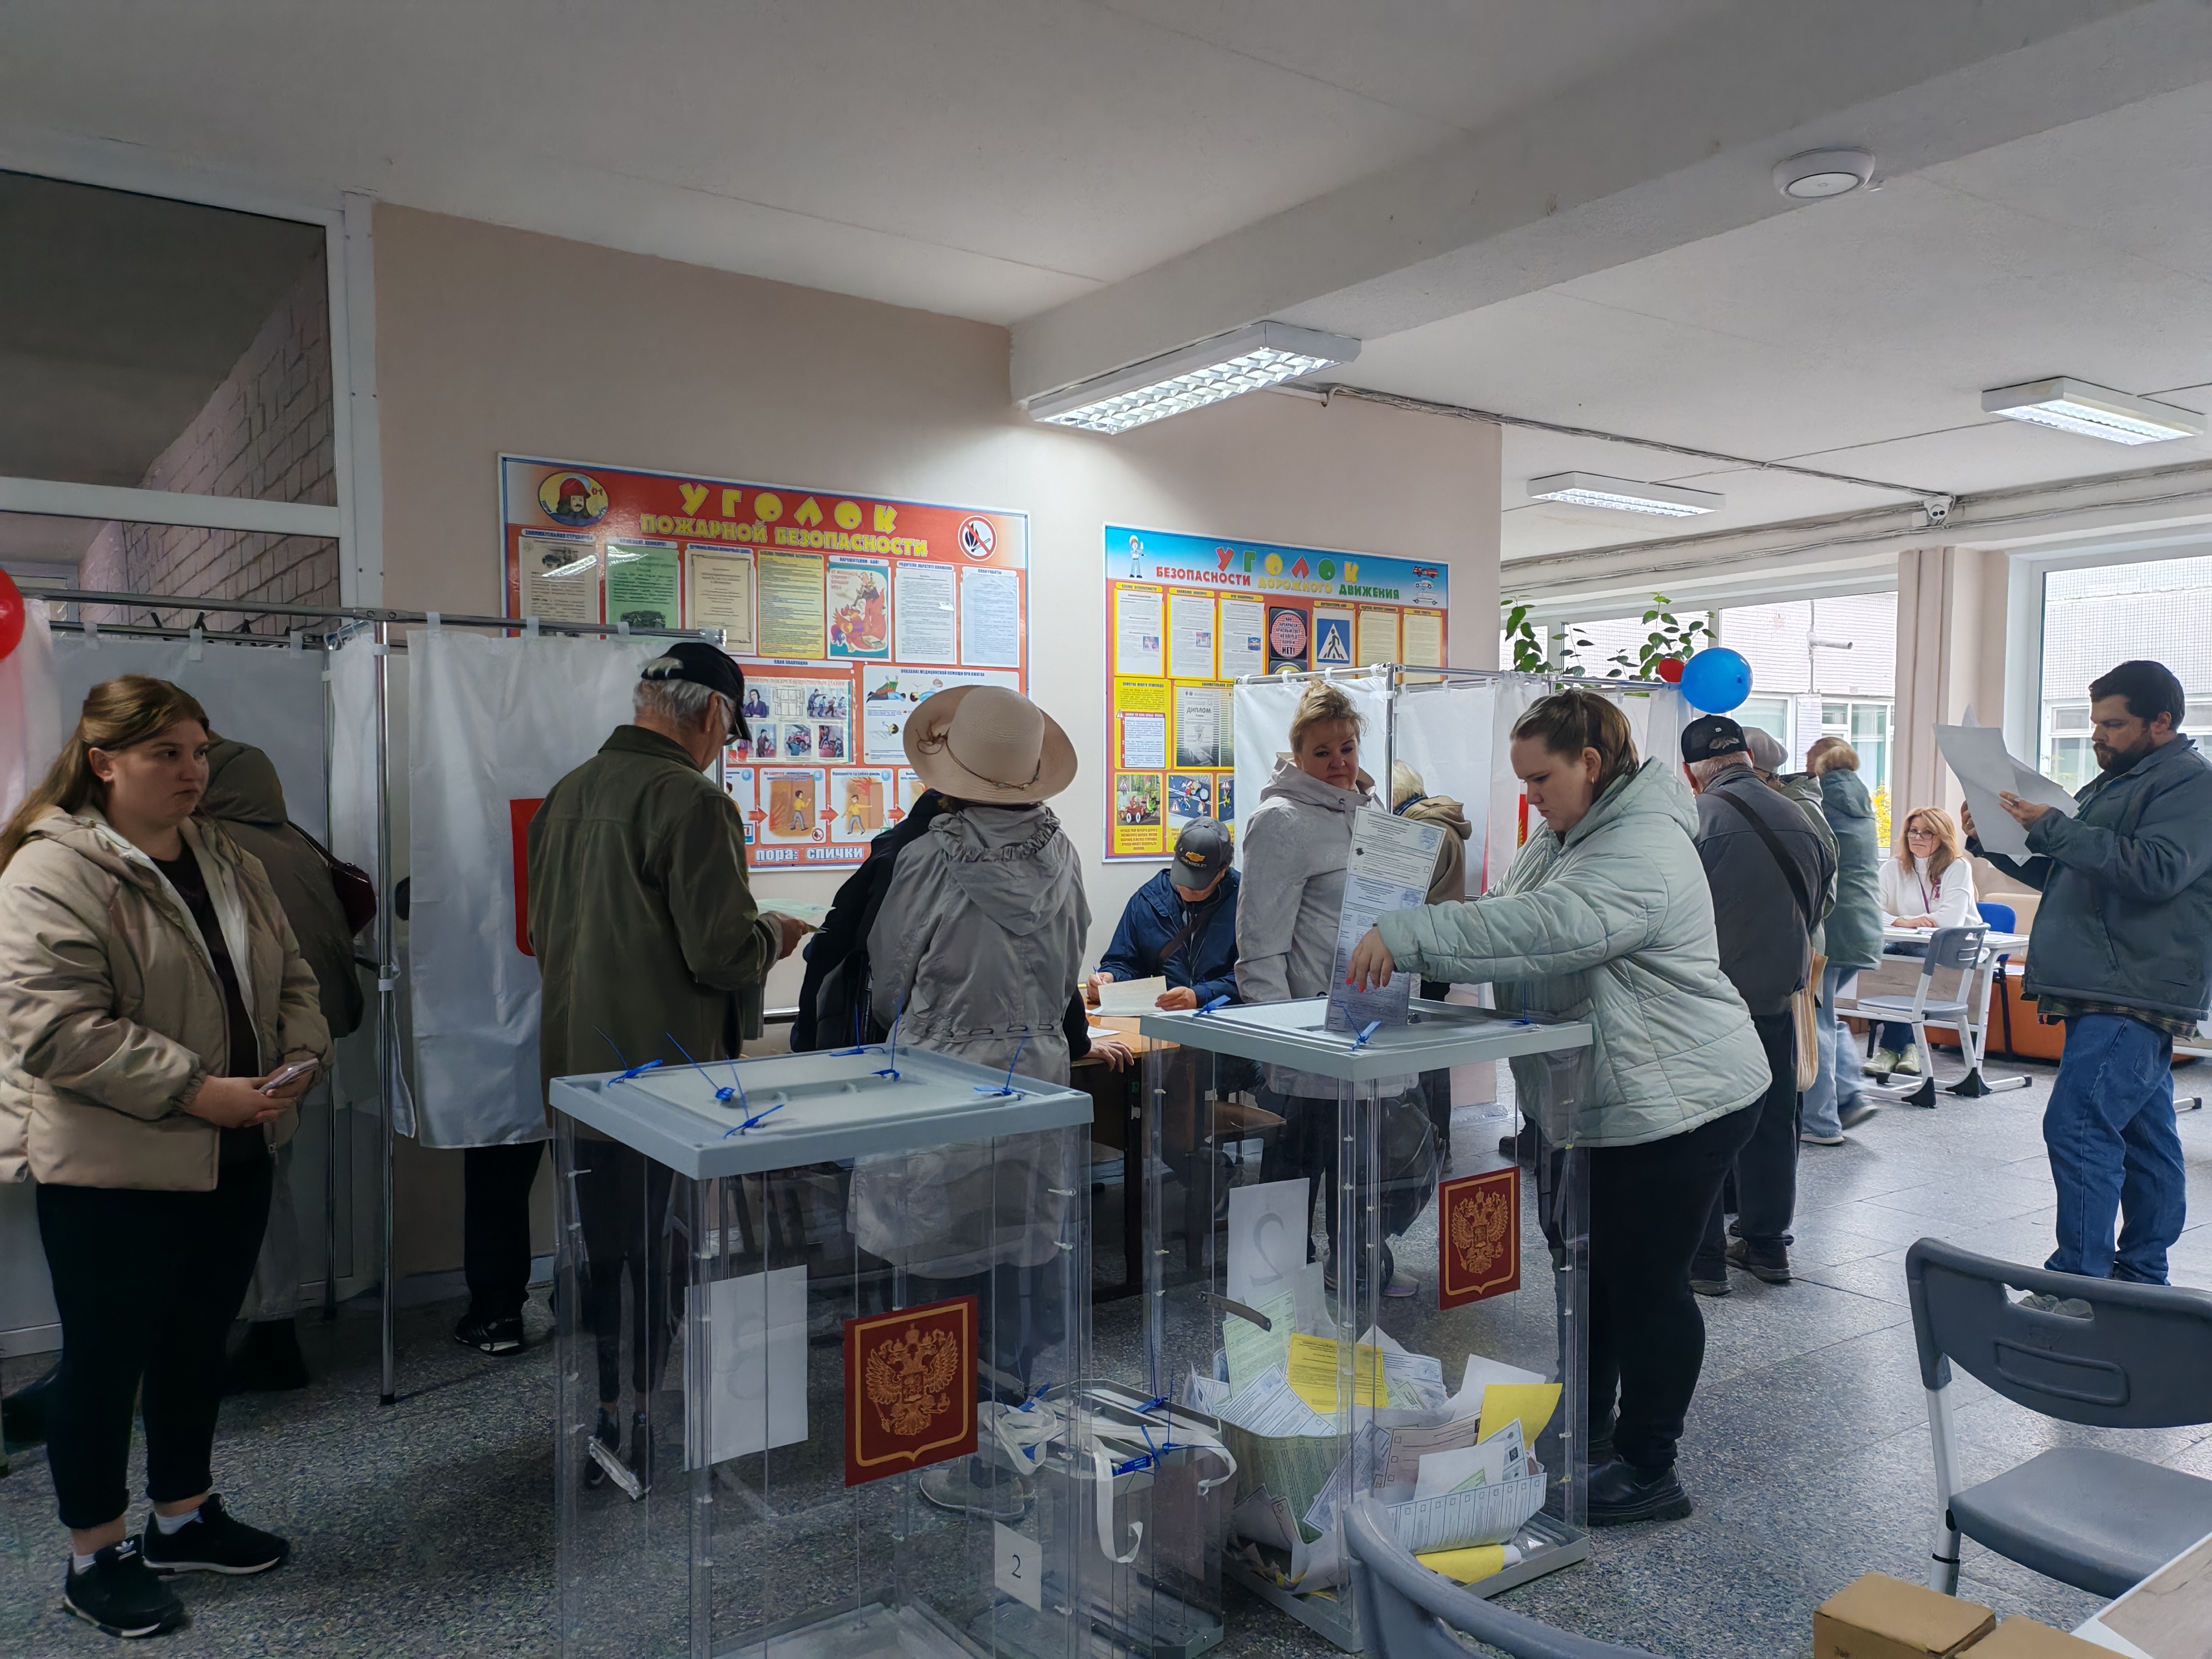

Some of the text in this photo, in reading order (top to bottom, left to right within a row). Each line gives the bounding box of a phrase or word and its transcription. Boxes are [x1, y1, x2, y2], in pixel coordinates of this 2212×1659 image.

[679, 482, 898, 534] УГОЛОК
[640, 514, 928, 557] ПОЖАРНОЙ БЕЗОПАСНОСТИ
[1216, 547, 1359, 584] УГОЛОК
[1156, 566, 1399, 599] БЕЗОПАСНОСТИ ДОРОЖНОГО ДВИЖЕНИЯ
[1282, 646, 1295, 655] НЕТ!
[755, 846, 864, 862] пора: спички
[1011, 1554, 1022, 1579] 2
